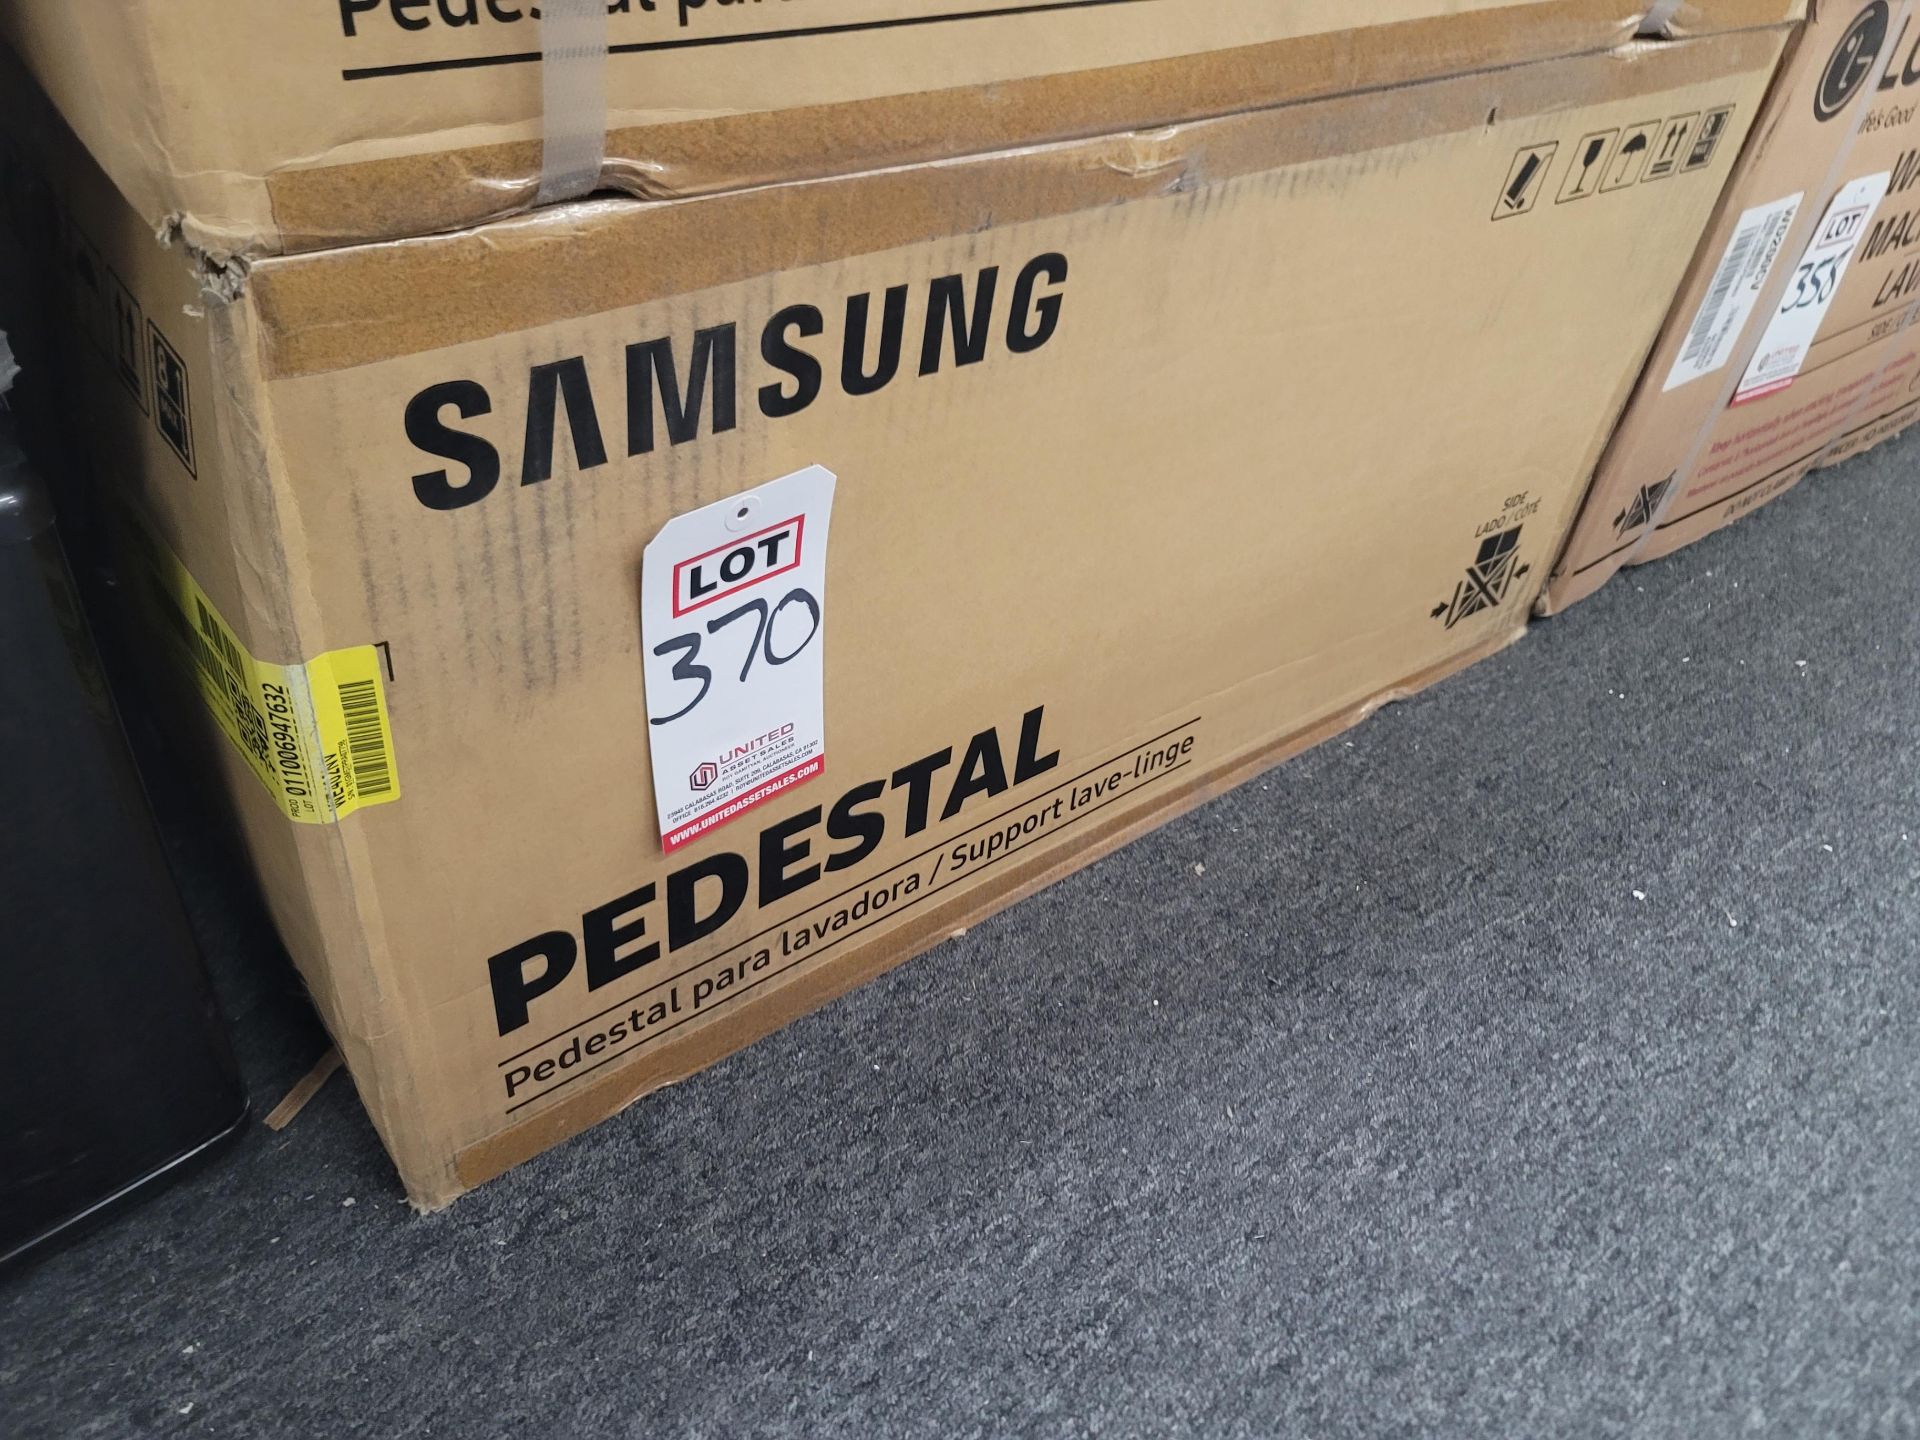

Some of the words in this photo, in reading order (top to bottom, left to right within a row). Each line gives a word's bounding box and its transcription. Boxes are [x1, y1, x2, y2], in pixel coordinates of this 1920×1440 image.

[1824, 213, 1861, 240] LOT
[1858, 208, 1920, 263] MAC
[1871, 259, 1920, 309] LAV
[404, 251, 1069, 511] SAMSUNG
[1474, 515, 1506, 538] LADO
[1502, 490, 1529, 512] SIDE
[690, 531, 790, 599] LOT
[651, 588, 820, 725] 370
[262, 683, 307, 797] 011006947632
[719, 722, 794, 765] UNITED
[722, 755, 757, 775] ASSET
[759, 736, 794, 757] SALES
[670, 761, 819, 846] WWW.UNITEDASSETSALES.COM
[685, 790, 717, 811] CALABASAS
[735, 775, 750, 785] SUITE
[762, 752, 795, 771] CALABASAS,
[795, 747, 803, 755] CA
[288, 799, 301, 818] PROD
[303, 800, 315, 813] LOT
[672, 810, 692, 824] OFFICE
[488, 704, 1061, 1037] PEDESTAL
[504, 987, 682, 1098] Pedestal
[693, 947, 771, 1009] para
[782, 872, 920, 956] lavadora
[928, 853, 945, 886] /
[950, 798, 1064, 872] Support
[1070, 734, 1195, 811] lave-linge
